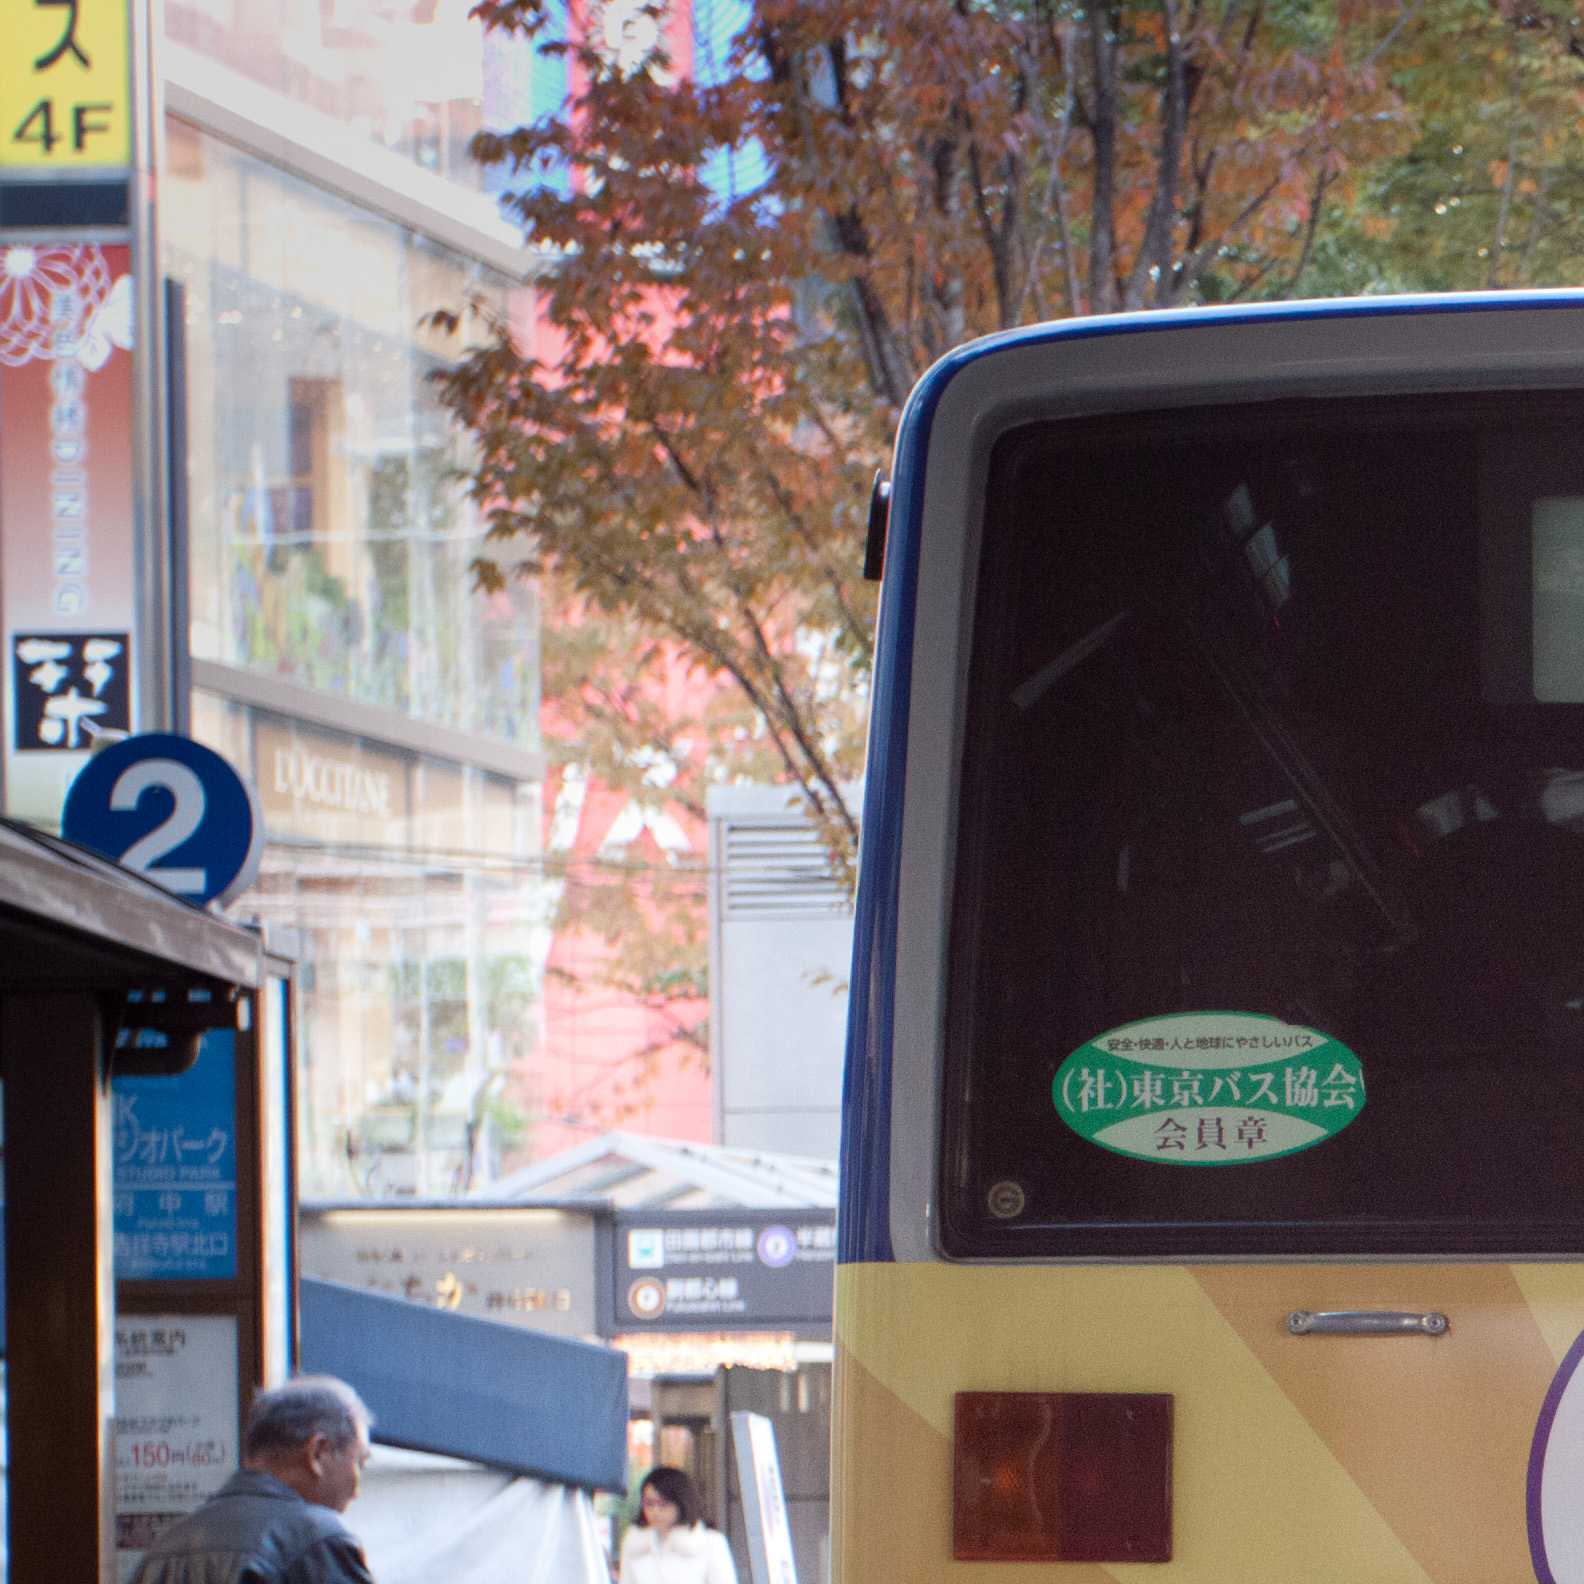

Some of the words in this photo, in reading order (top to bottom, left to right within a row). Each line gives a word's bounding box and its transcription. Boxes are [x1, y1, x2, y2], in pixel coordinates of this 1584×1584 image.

[13, 98, 114, 153] 4F
[109, 757, 206, 896] 2
[1153, 1116, 1267, 1151] 会員章
